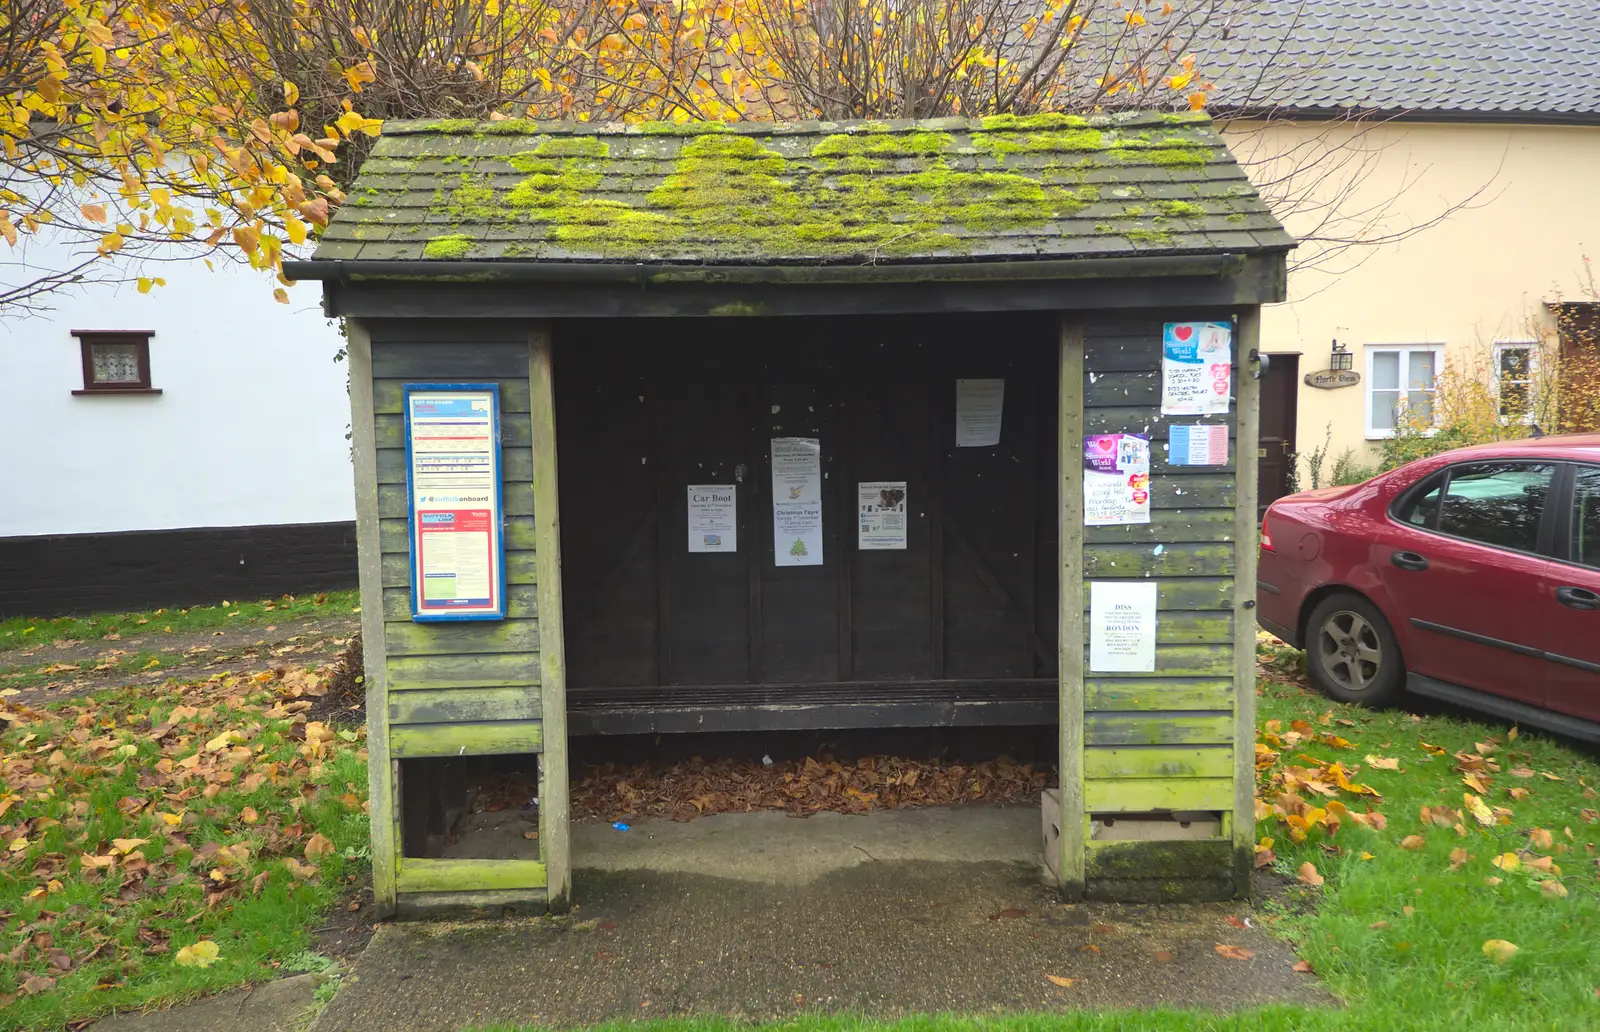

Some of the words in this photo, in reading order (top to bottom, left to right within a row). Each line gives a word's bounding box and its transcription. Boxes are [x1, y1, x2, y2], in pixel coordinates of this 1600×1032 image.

[1171, 347, 1192, 355] World
[1315, 375, 1336, 383] North
[1086, 440, 1099, 448] We
[1085, 452, 1116, 461] Slimming
[1091, 459, 1112, 467] World
[428, 495, 489, 503] @suffolkonboard
[693, 494, 710, 502] Car
[712, 494, 731, 502] Boot
[804, 509, 819, 517] Fayre
